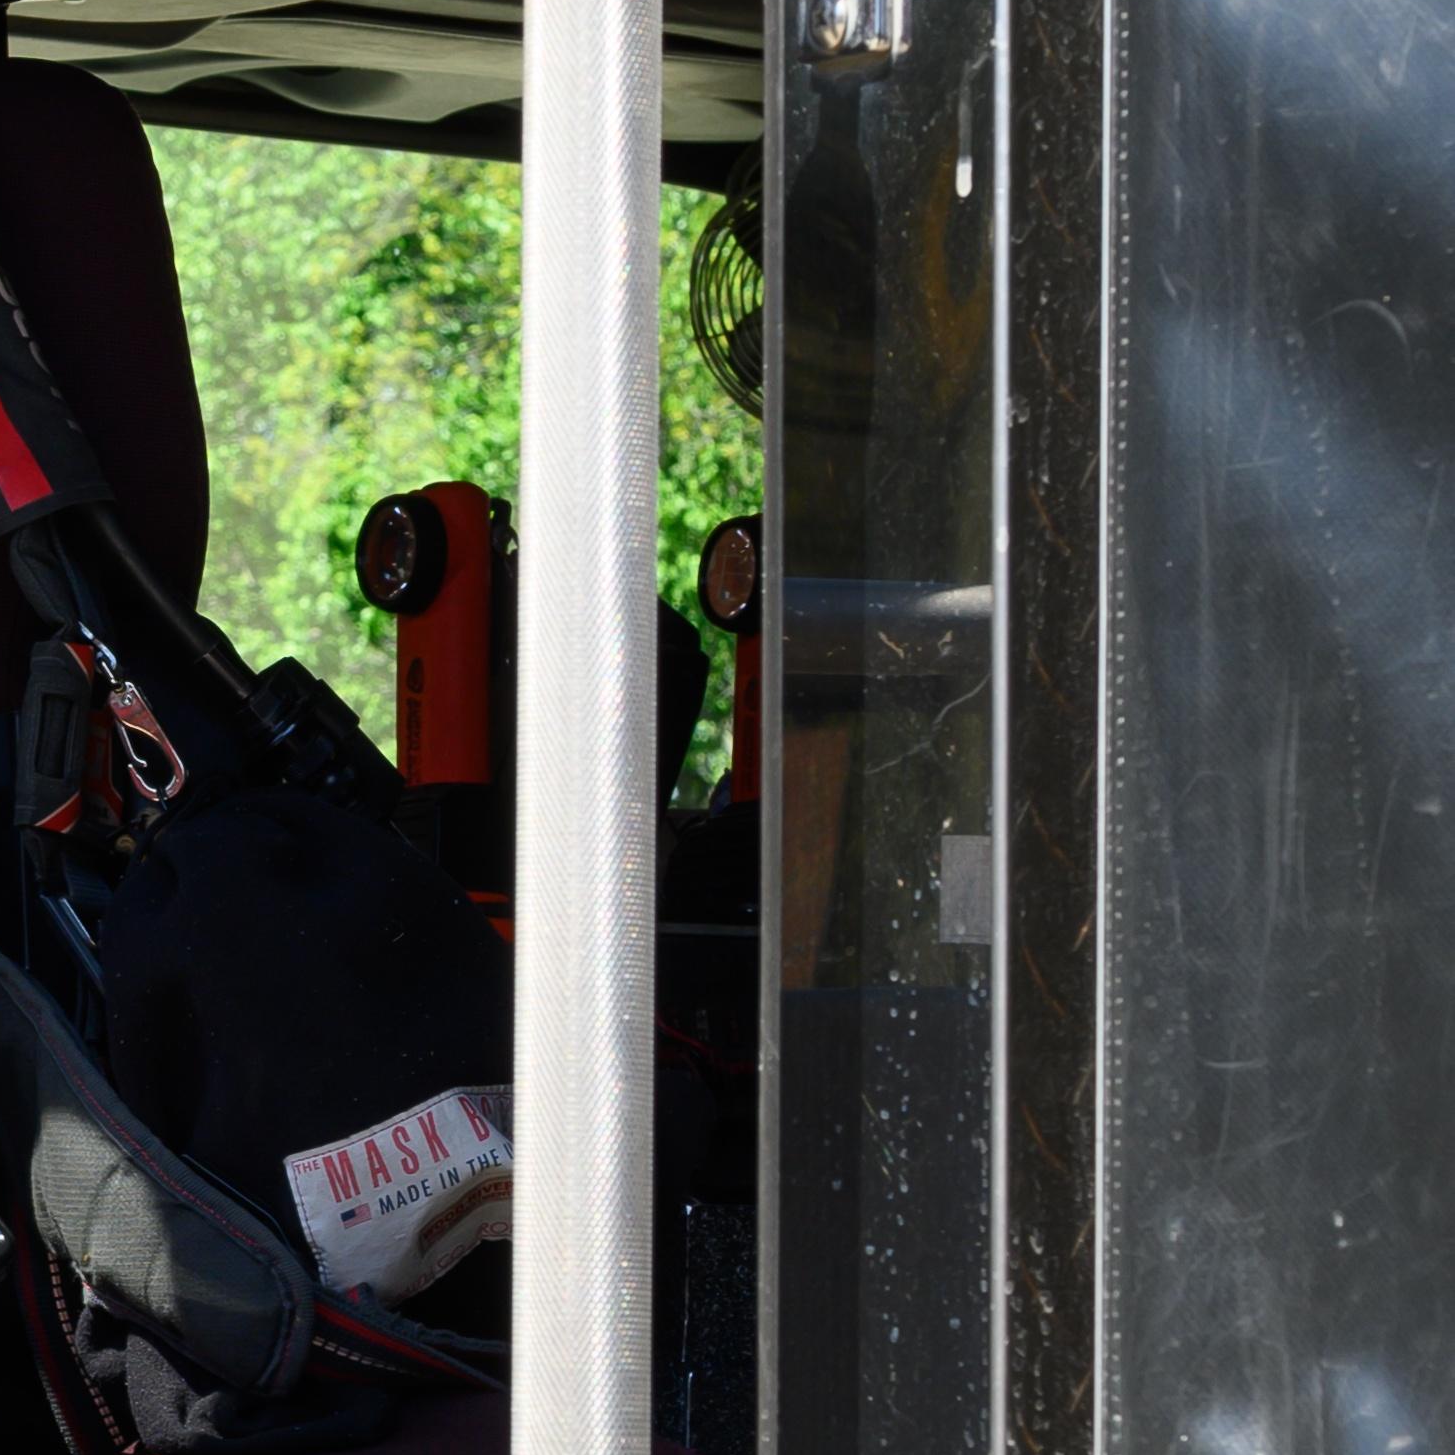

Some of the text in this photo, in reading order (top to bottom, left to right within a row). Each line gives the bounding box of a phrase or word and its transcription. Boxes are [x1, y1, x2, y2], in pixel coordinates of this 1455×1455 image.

[295, 1159, 320, 1175] THE
[322, 1110, 450, 1203] MASK
[378, 1179, 433, 1215] MADE
[440, 1166, 461, 1190] IN
[465, 1148, 503, 1176] THE
